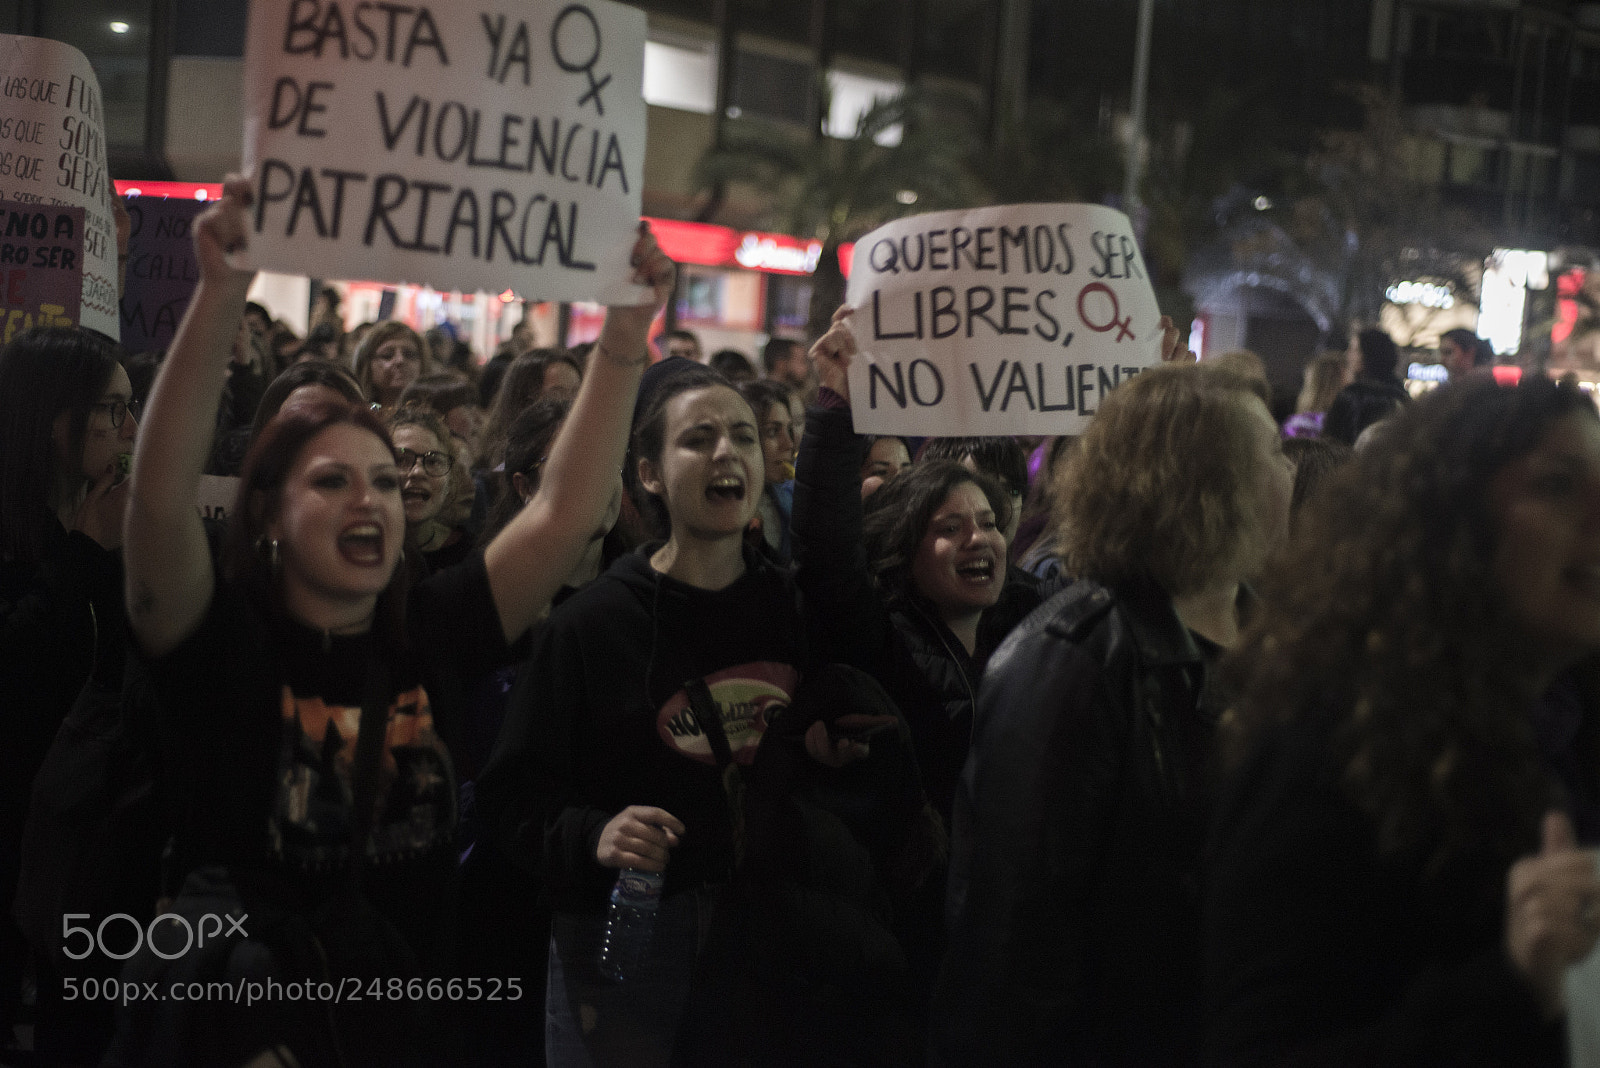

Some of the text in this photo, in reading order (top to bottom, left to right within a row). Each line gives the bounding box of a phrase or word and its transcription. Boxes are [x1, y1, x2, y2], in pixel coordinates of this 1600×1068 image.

[285, 0, 531, 86] BASTA YA
[30, 79, 59, 104] QUE
[15, 119, 45, 144] QUE
[268, 76, 630, 195] DE VIOLENCIA
[15, 155, 44, 181] QUE
[254, 158, 596, 271] PATRIARCAL
[32, 245, 76, 271] SER
[870, 223, 1074, 275] QUEREMOS
[1088, 230, 1143, 281] SER
[873, 285, 1075, 348] LIBRES,
[869, 358, 1150, 417] NO VALIENT
